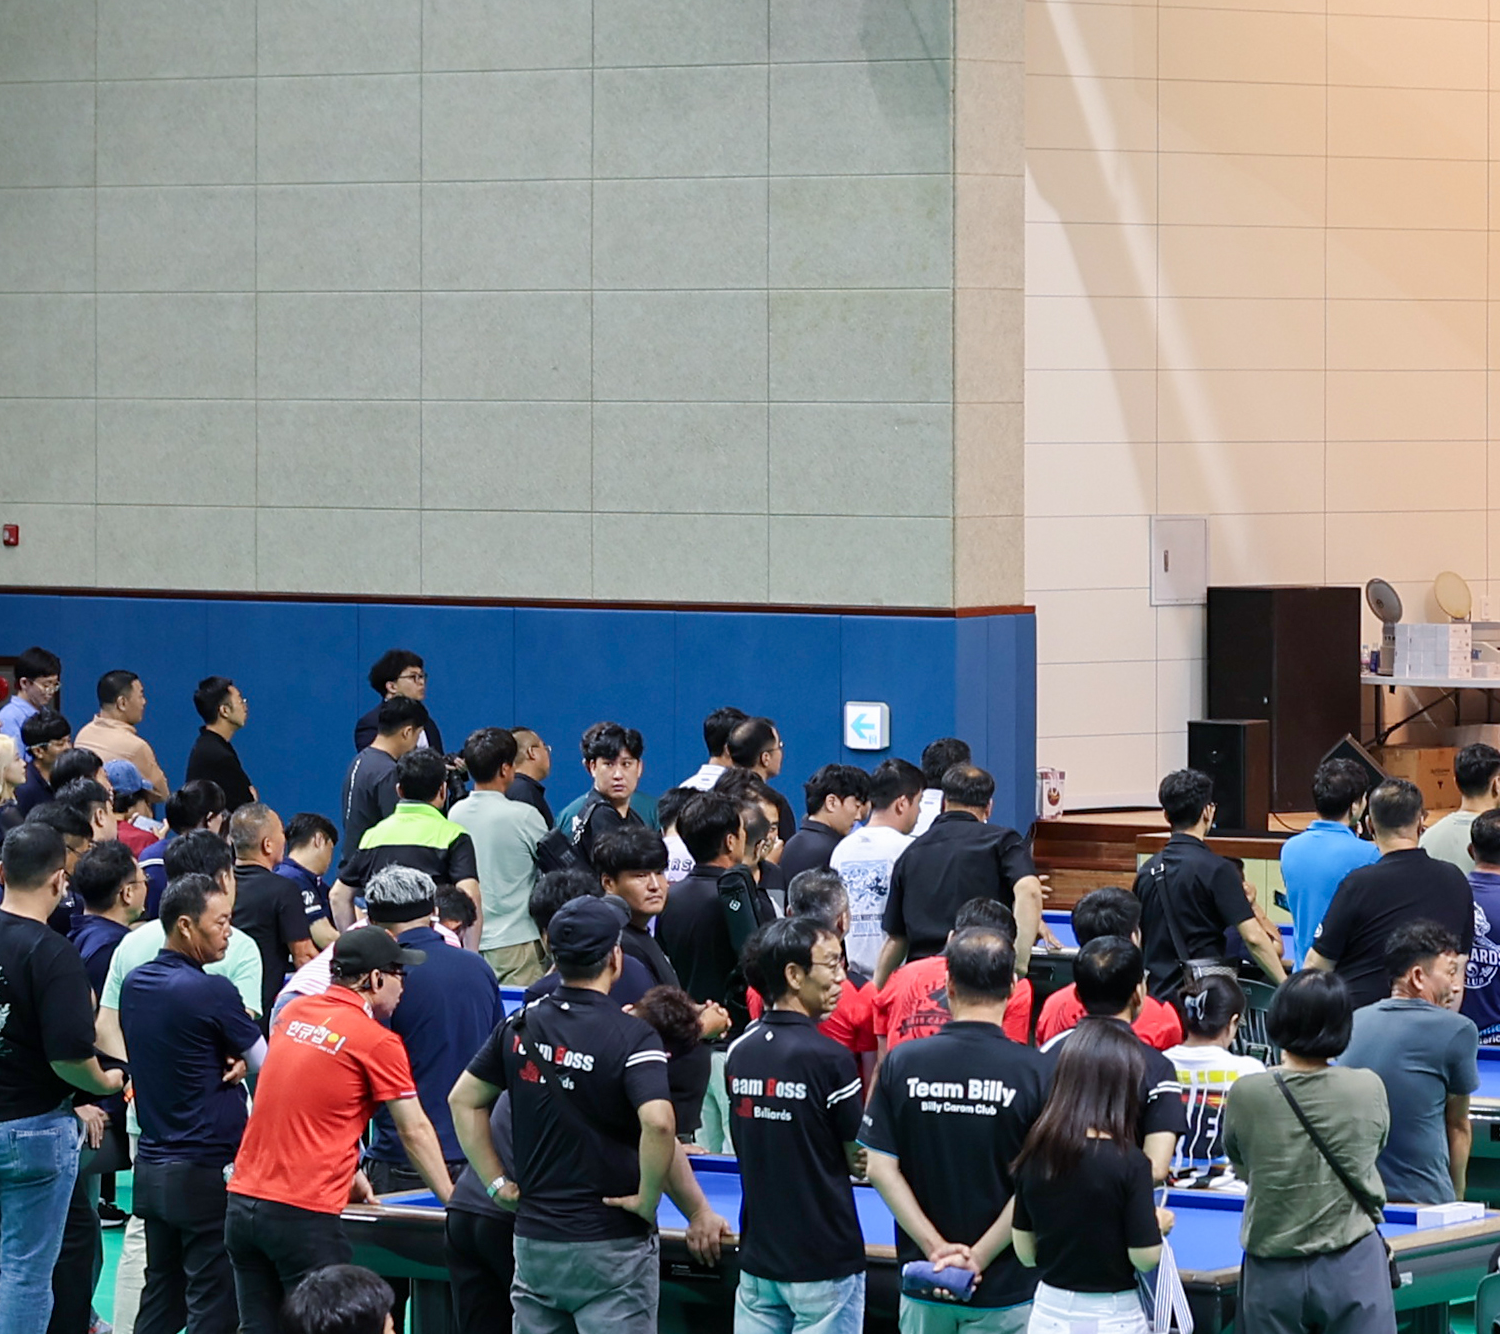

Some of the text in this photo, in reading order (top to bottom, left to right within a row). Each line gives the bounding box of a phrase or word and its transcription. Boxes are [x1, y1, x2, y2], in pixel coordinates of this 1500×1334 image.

[906, 1077, 1017, 1108] Team Billy
[921, 1101, 943, 1114] Billy
[975, 1103, 998, 1116] Club
